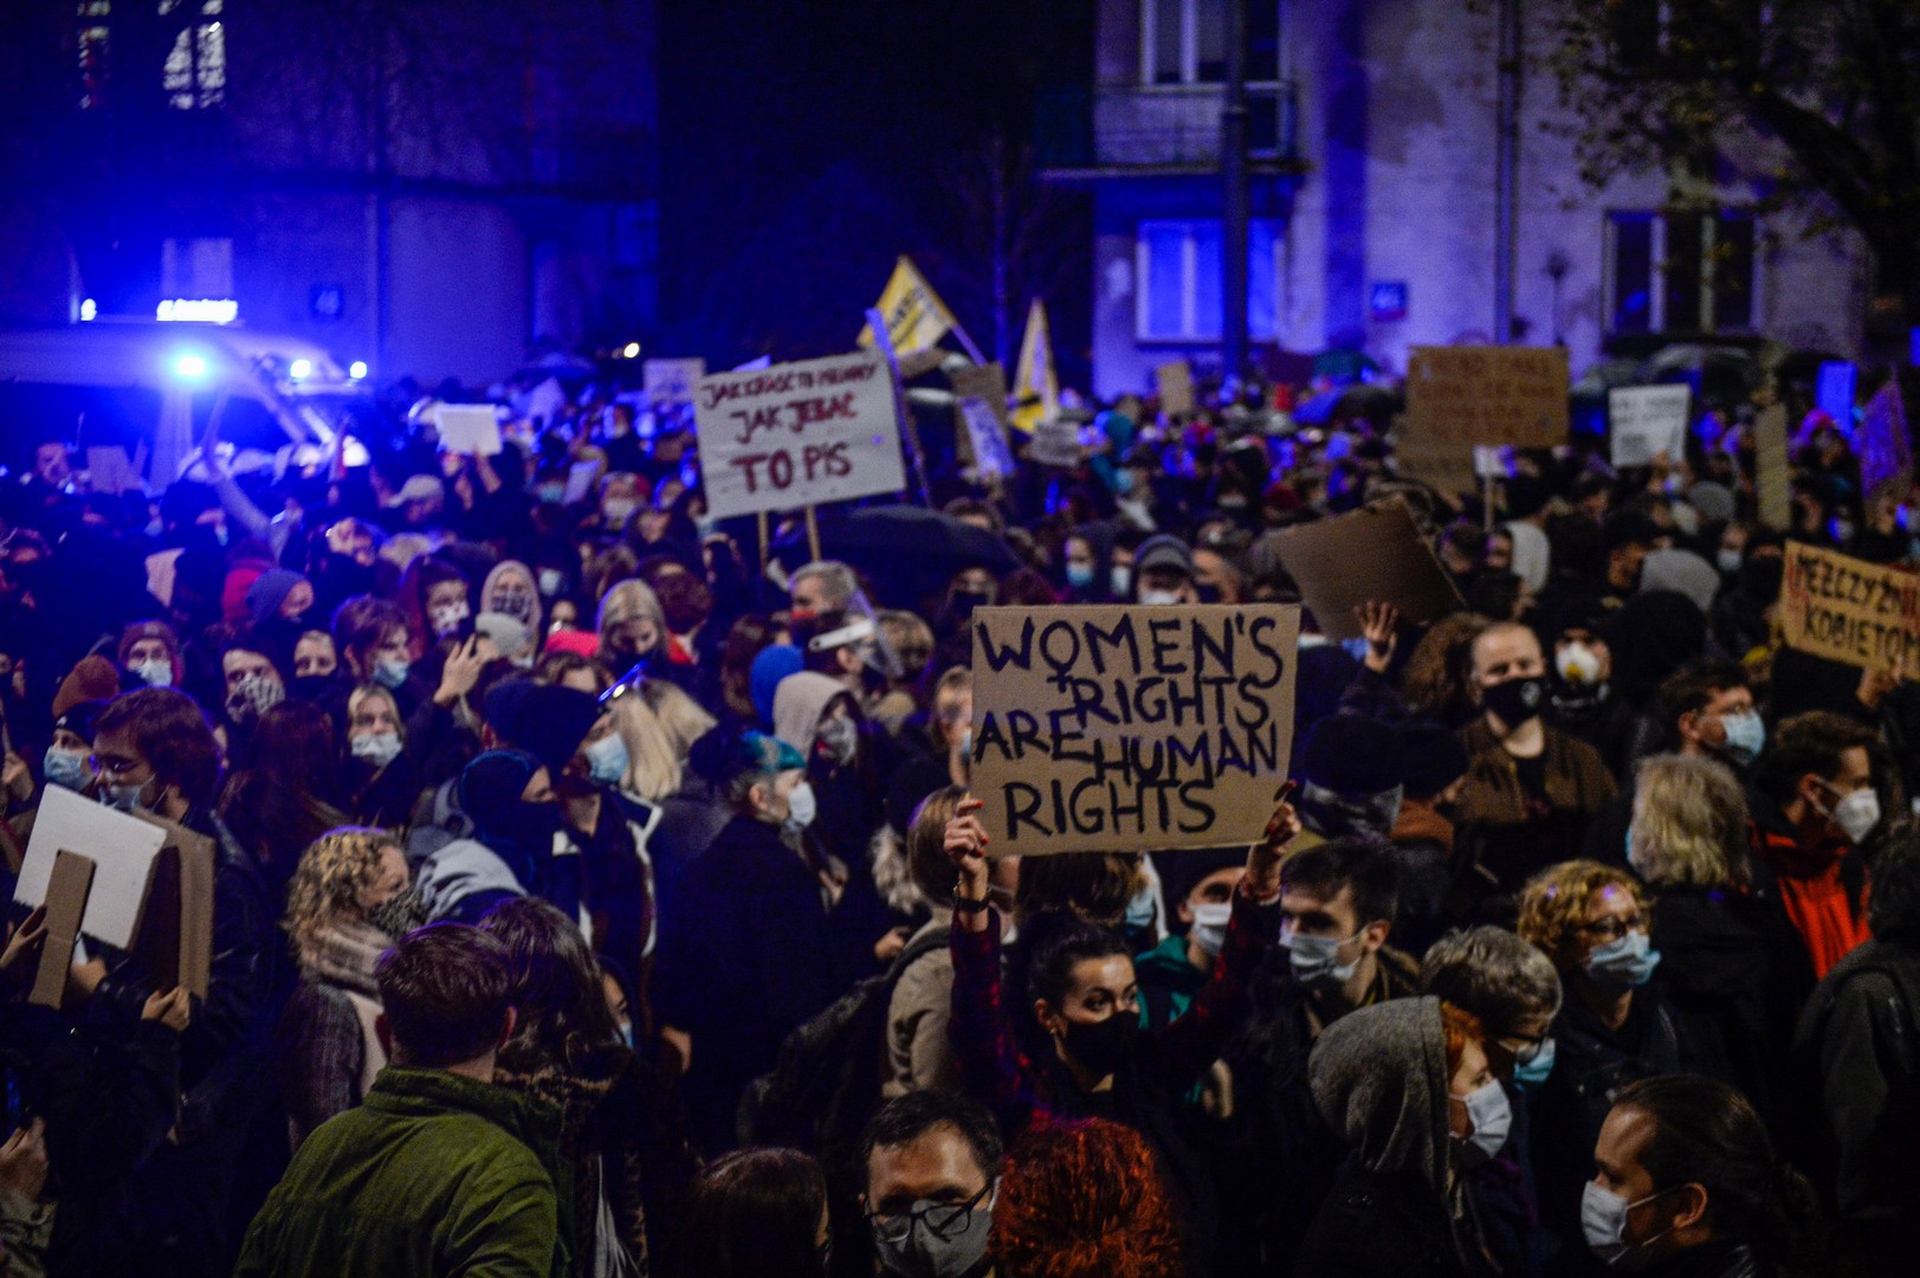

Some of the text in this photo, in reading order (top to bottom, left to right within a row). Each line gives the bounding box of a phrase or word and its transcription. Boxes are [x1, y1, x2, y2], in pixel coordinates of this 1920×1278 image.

[729, 405, 783, 444] JAK
[729, 449, 794, 493] TO
[975, 612, 1284, 692] WOMEN'S
[1071, 674, 1271, 730] RIGHTS
[974, 708, 1278, 789] ARE HUMAN
[1002, 777, 1217, 840] RIGHTS
